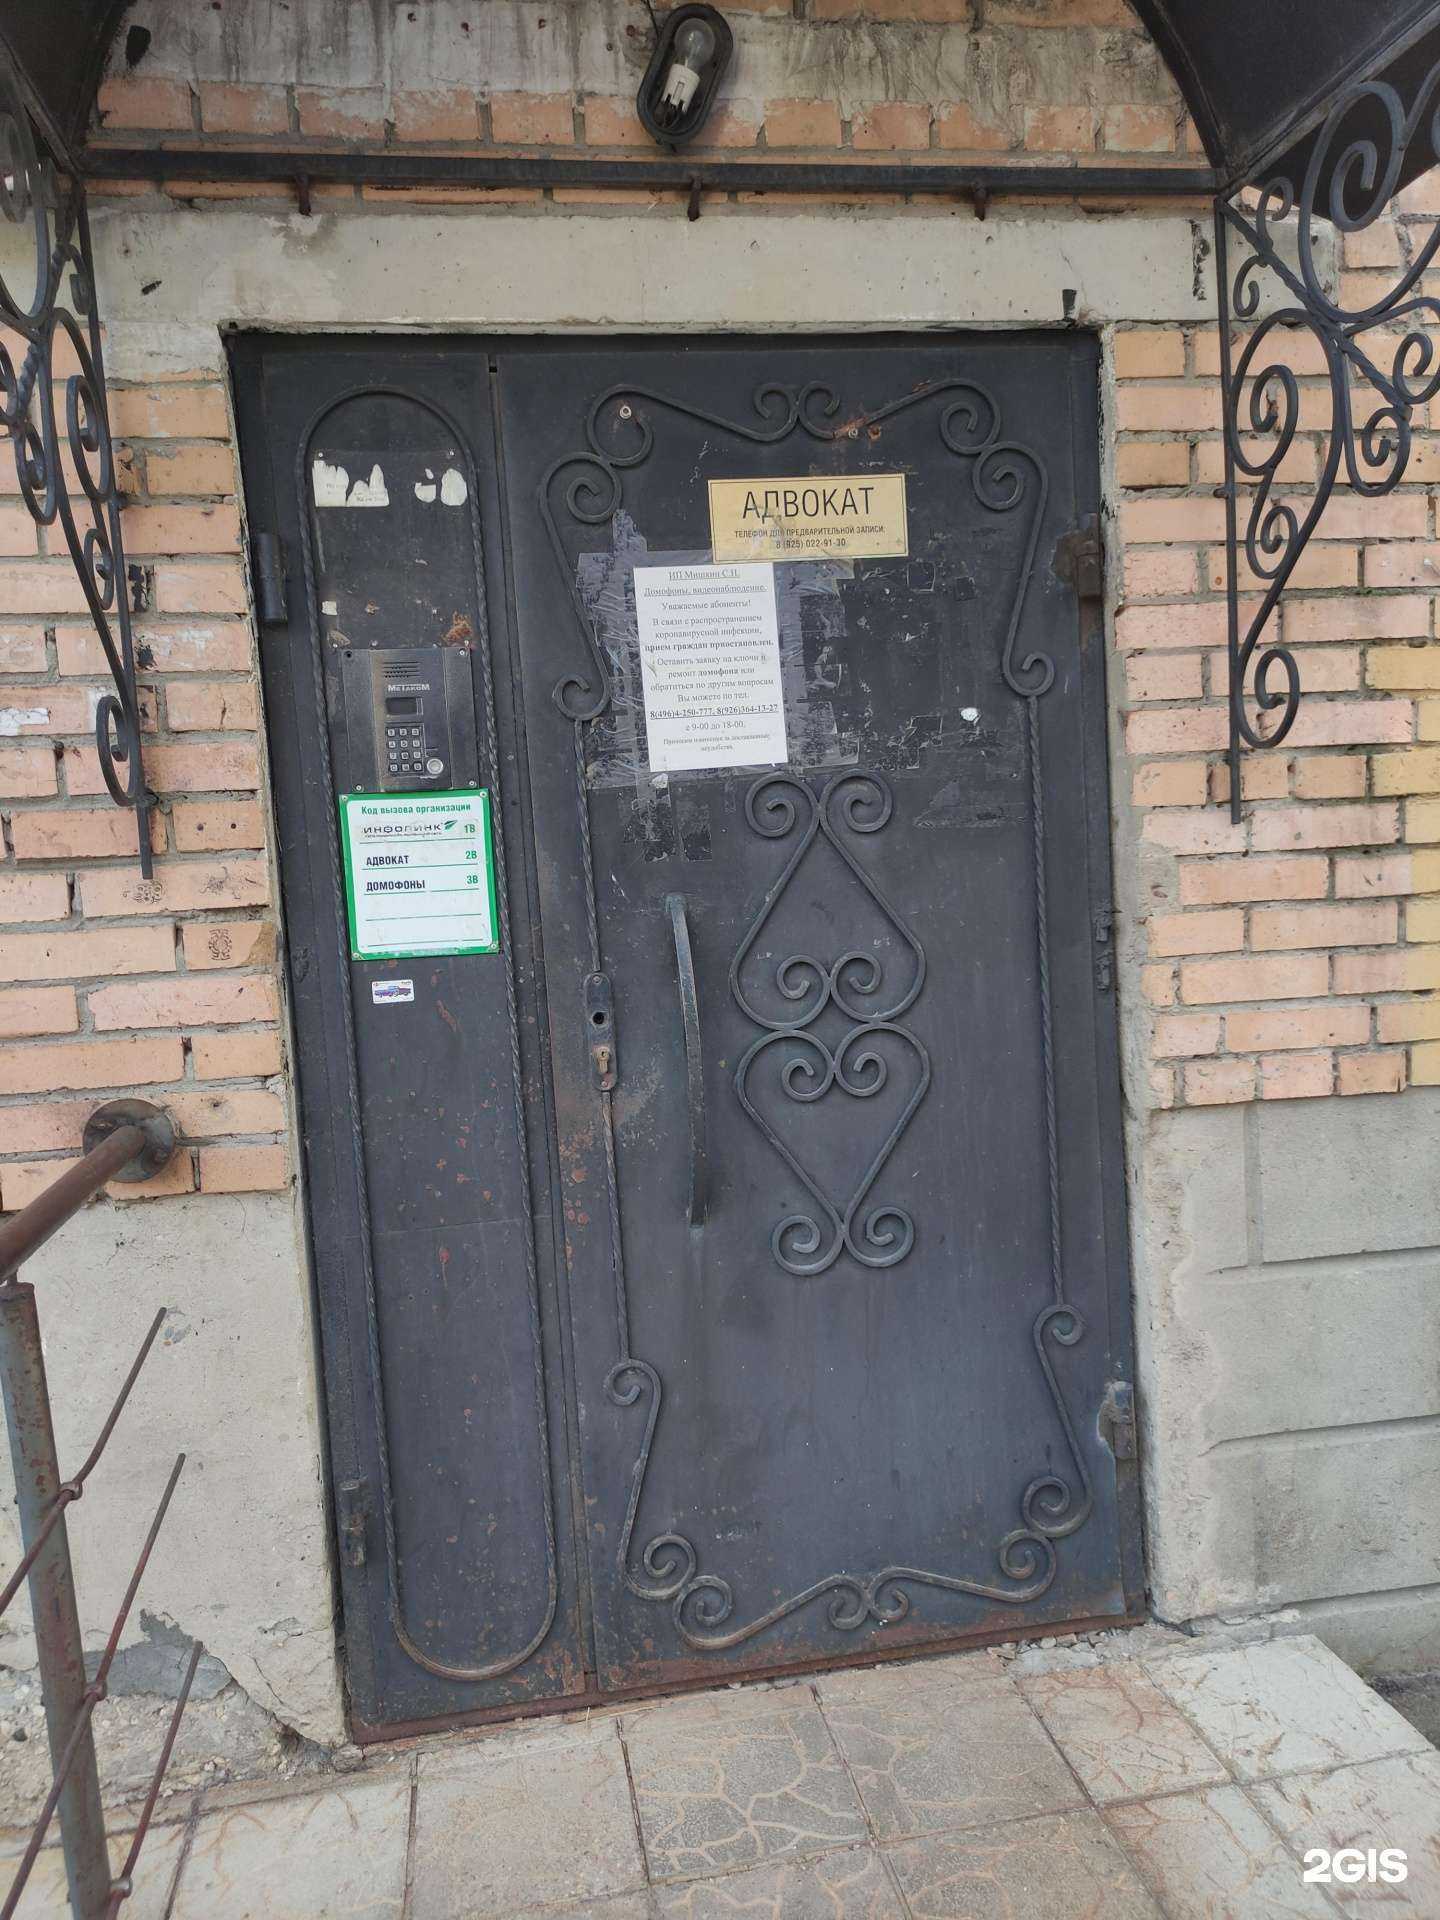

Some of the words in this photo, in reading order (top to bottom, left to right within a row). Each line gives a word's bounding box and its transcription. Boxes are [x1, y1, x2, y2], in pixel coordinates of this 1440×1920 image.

[742, 487, 875, 524] АДВОКАТ
[735, 530, 768, 538] ТЕЛЕФОН
[786, 527, 855, 537] ПРЕДВАРИТЕЛЬНОЙ
[783, 540, 804, 549] (925)
[805, 538, 846, 547] 022-91-30
[669, 571, 682, 580] ИП
[662, 602, 709, 610] Уважаемые
[710, 600, 751, 609] абоненты!
[652, 618, 659, 626] В
[691, 616, 762, 626] распространением
[655, 630, 719, 641] коронавирусной
[721, 627, 762, 636] инфекции,
[645, 643, 671, 653] прием
[673, 642, 708, 652] граждан
[710, 639, 774, 650] приостановлен.
[657, 657, 694, 665] Оставить
[696, 656, 720, 666] заявку
[668, 671, 696, 679] ремонт
[698, 668, 738, 677] домофона
[650, 682, 694, 692] обратиться
[708, 680, 736, 690] другим
[737, 678, 774, 687] вопросам
[716, 704, 778, 715] 8(926)364-13-27
[692, 722, 709, 730] 9-00
[361, 806, 378, 815] Код
[380, 806, 413, 814] вызова
[416, 803, 471, 815] организации
[366, 855, 410, 867] АДВОКАТ
[366, 880, 426, 892] ДОМОФОНЫ
